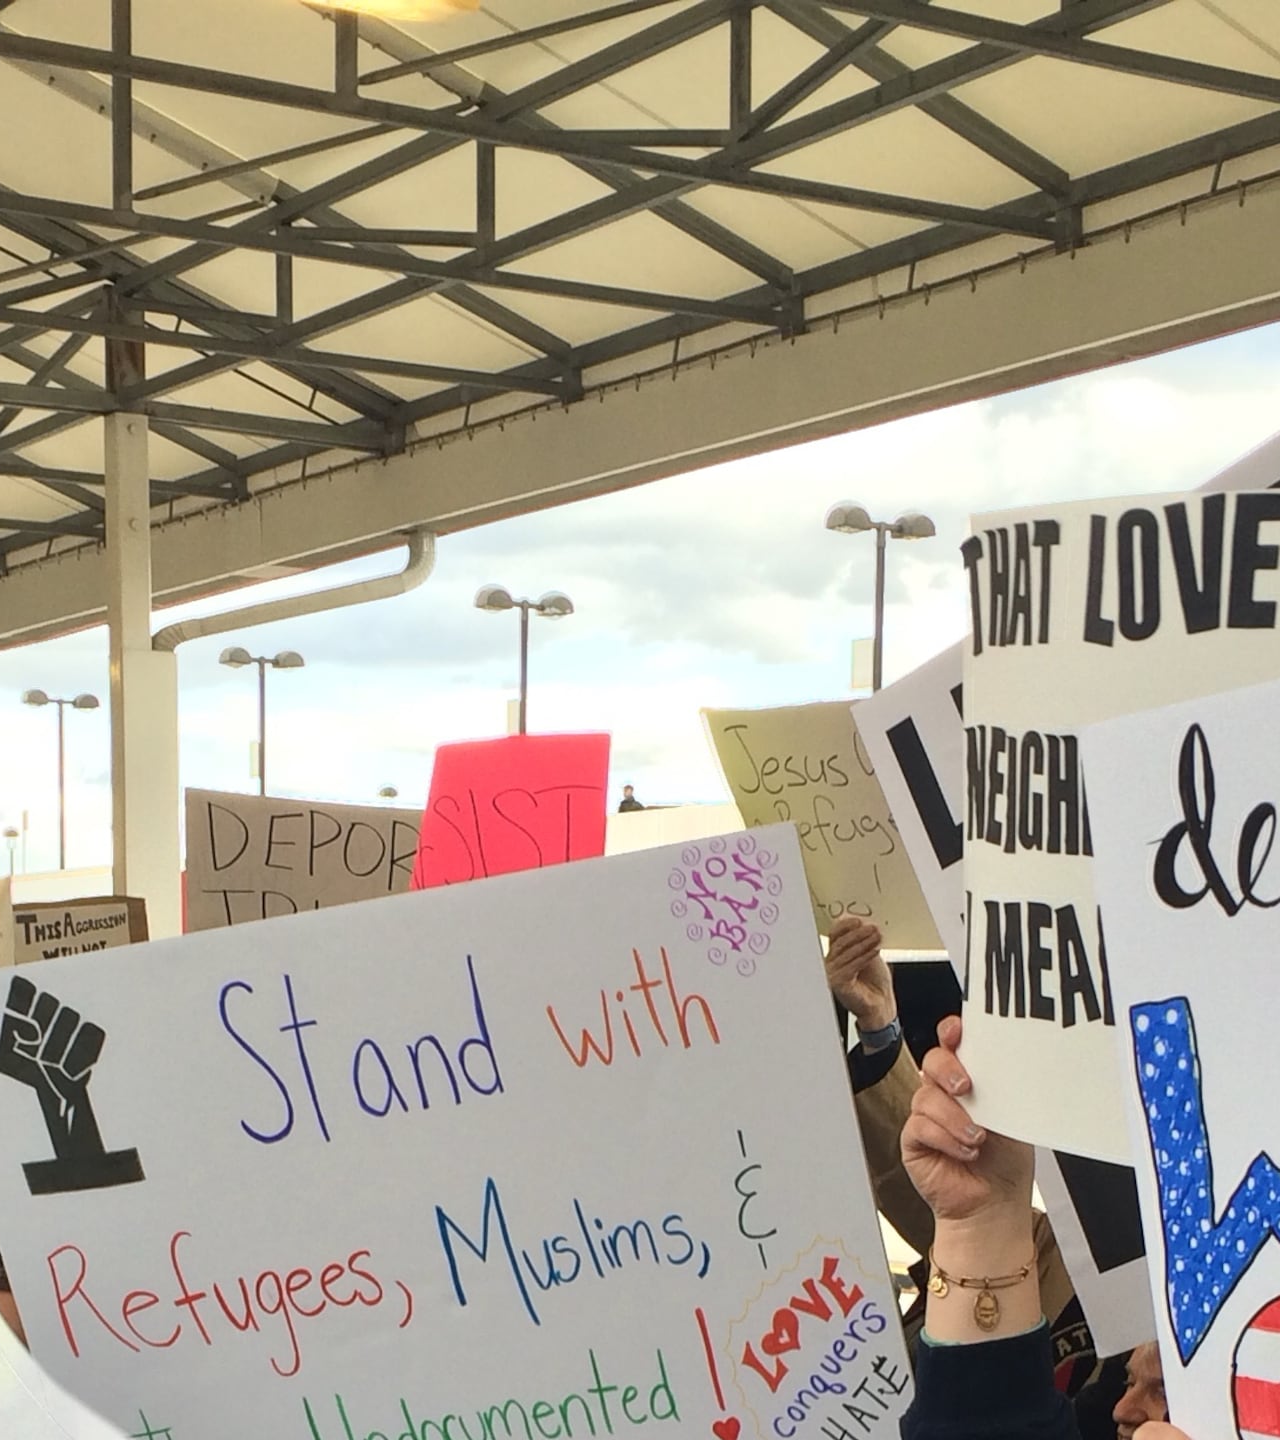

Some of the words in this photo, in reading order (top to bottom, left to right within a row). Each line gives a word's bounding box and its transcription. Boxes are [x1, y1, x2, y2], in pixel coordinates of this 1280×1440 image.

[961, 518, 1061, 656] THAT
[723, 724, 849, 795] Jesus
[207, 801, 420, 891] DEPOR
[419, 784, 603, 890] SIST
[685, 856, 728, 920] NO
[709, 852, 765, 952] BAN
[983, 900, 1116, 1029] MEA
[219, 954, 505, 1145] Stand
[546, 946, 721, 1068] with
[46, 1231, 413, 1377] Refugees,
[435, 1176, 711, 1326] Muslims,
